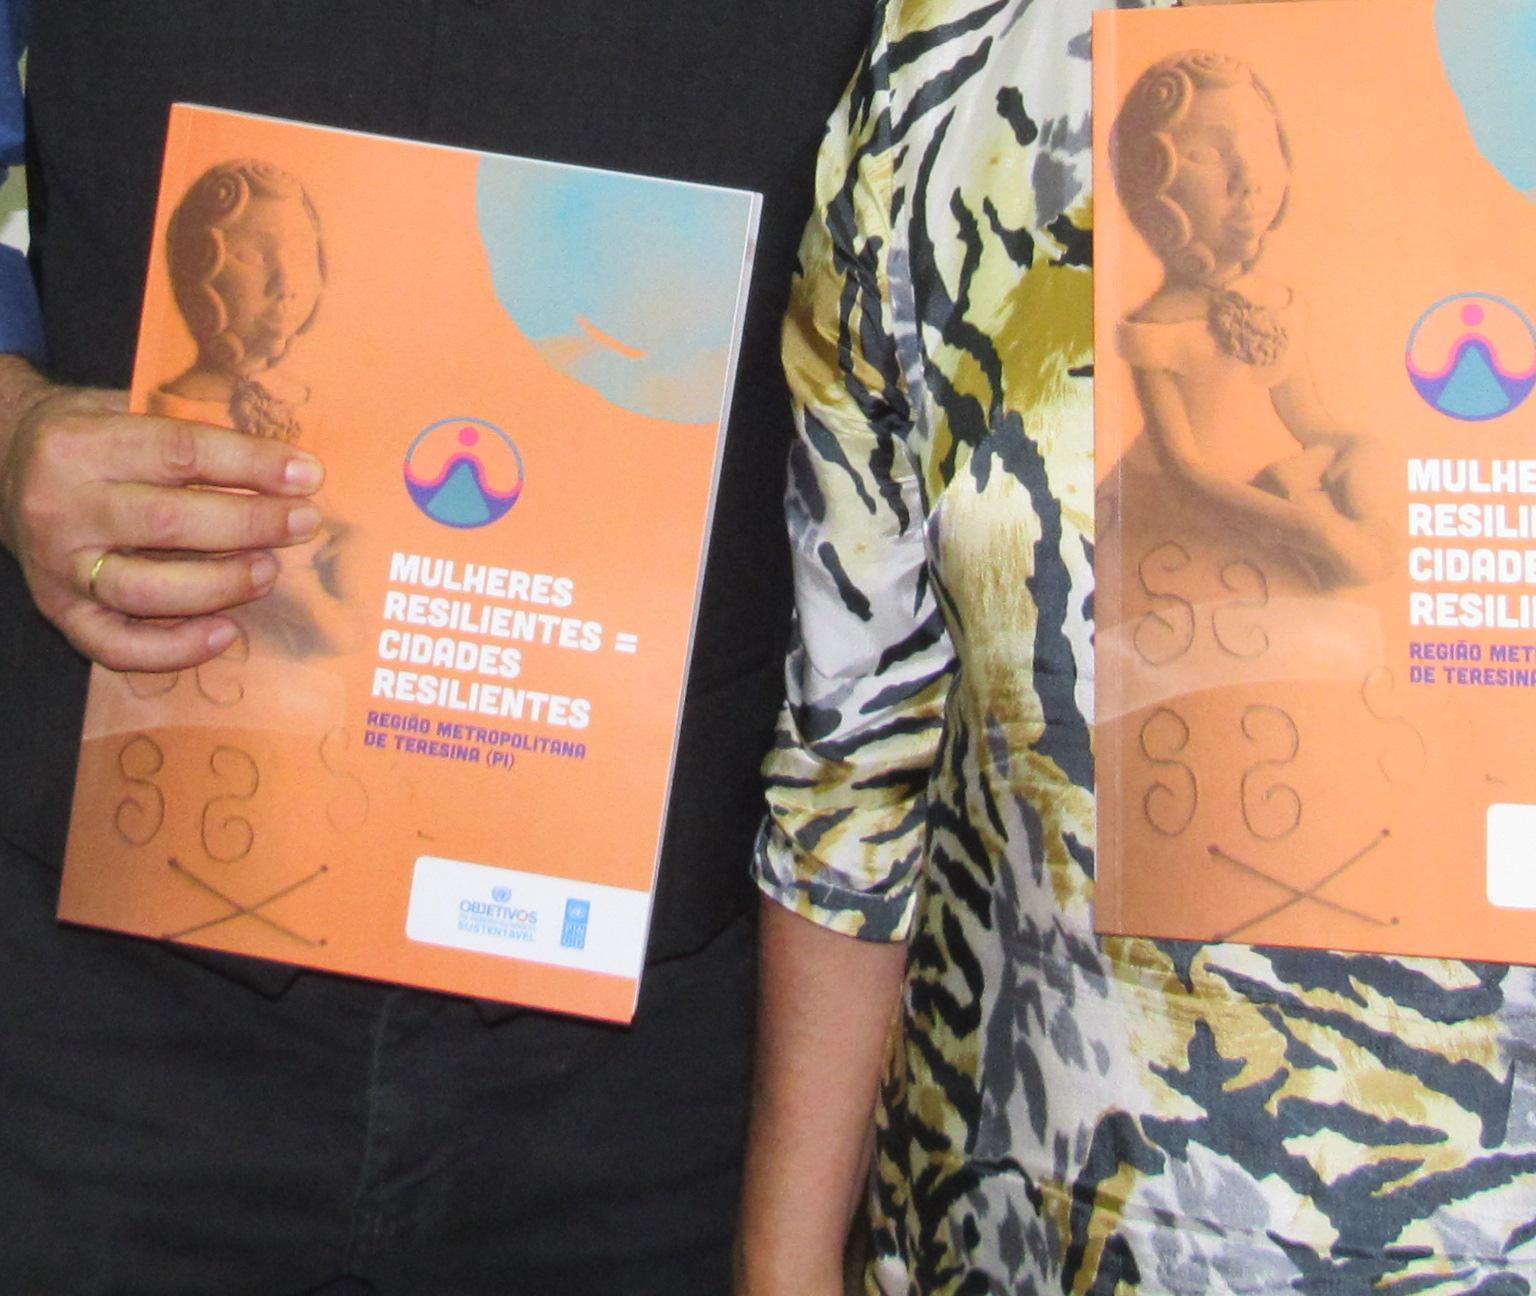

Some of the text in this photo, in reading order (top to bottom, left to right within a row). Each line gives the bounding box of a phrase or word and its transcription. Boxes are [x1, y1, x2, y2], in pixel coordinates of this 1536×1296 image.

[388, 551, 575, 608] MULHERES
[383, 590, 639, 654] RESILIENTES =
[377, 628, 523, 680] CIDADES
[1409, 640, 1482, 661] REGIÃO
[1409, 666, 1436, 684] DE
[371, 667, 592, 729] RESILIENTES
[364, 730, 515, 770] DE TERESINA (PI)
[367, 710, 587, 760] REGIÃO METROPOLITANA
[459, 899, 538, 924] OBJETIVOS
